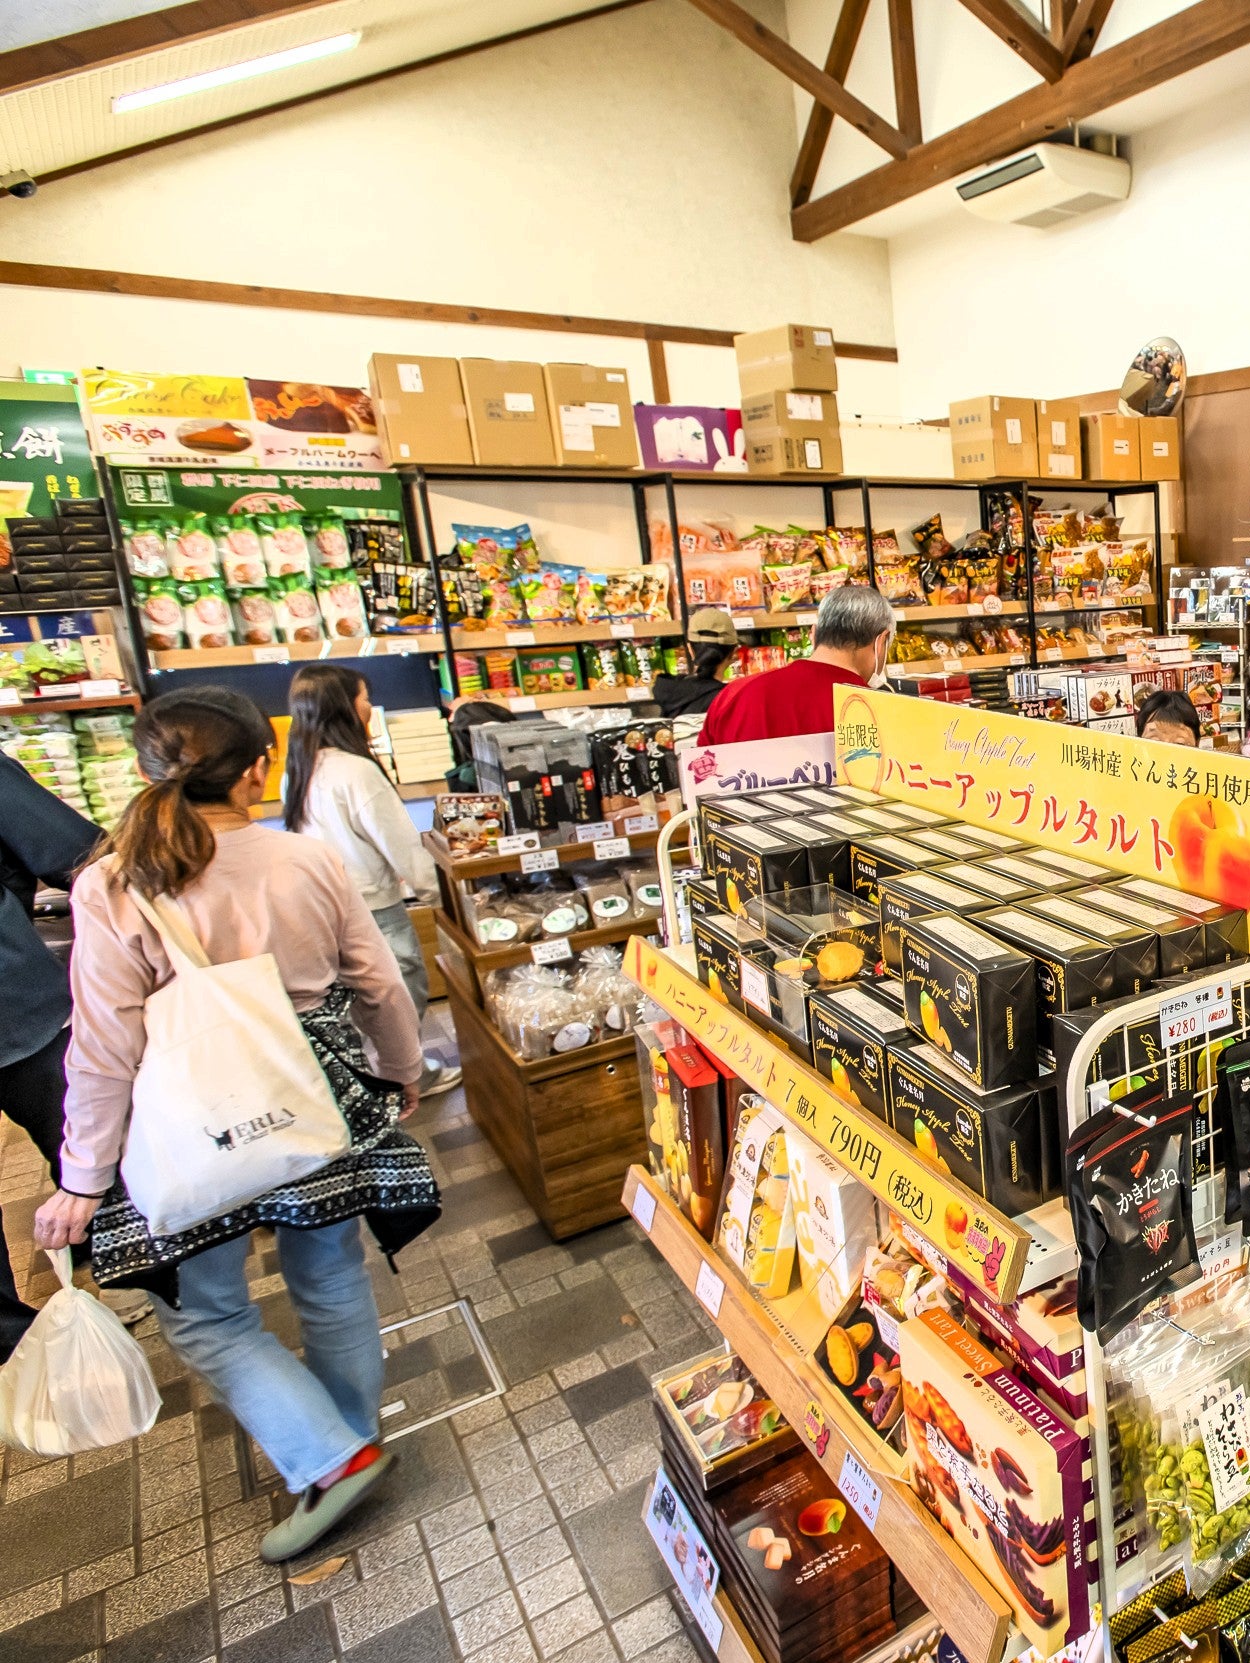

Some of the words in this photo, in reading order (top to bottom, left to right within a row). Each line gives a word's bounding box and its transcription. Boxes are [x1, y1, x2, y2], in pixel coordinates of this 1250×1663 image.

[837, 723, 880, 749] 当店限定
[944, 718, 970, 765] Honey
[974, 727, 1009, 767] Apple
[1008, 736, 1037, 769] Tart
[718, 761, 837, 791] ブルーベリ
[1061, 743, 1122, 778] 川場村産
[885, 758, 1175, 872] ハニーアップルタルト
[908, 950, 930, 973] ぐんま名月
[906, 968, 925, 991] Honey
[927, 980, 951, 1001] Apple
[949, 1001, 969, 1028] Tart
[1161, 1001, 1188, 1016] かきたね
[666, 984, 776, 1088] ハニーアップルタルト
[818, 1020, 838, 1042] ぐんま名月
[1168, 1017, 1196, 1038] ¥280
[816, 1037, 835, 1057] Honey
[836, 1048, 860, 1068] Apple
[788, 1078, 817, 1130] 7個入
[899, 1077, 925, 1102] ぐんま名月
[896, 1095, 920, 1119] Honey
[922, 1108, 951, 1133] Apple
[830, 1116, 882, 1180] 790円
[888, 1169, 934, 1225] (税込)
[1116, 1168, 1180, 1216] かきたね
[928, 1312, 958, 1340] Tart
[953, 1335, 993, 1374] Sweet
[994, 1374, 1065, 1441] Platinum
[1220, 1402, 1242, 1451] わさび
[1215, 1424, 1239, 1484] そら豆
